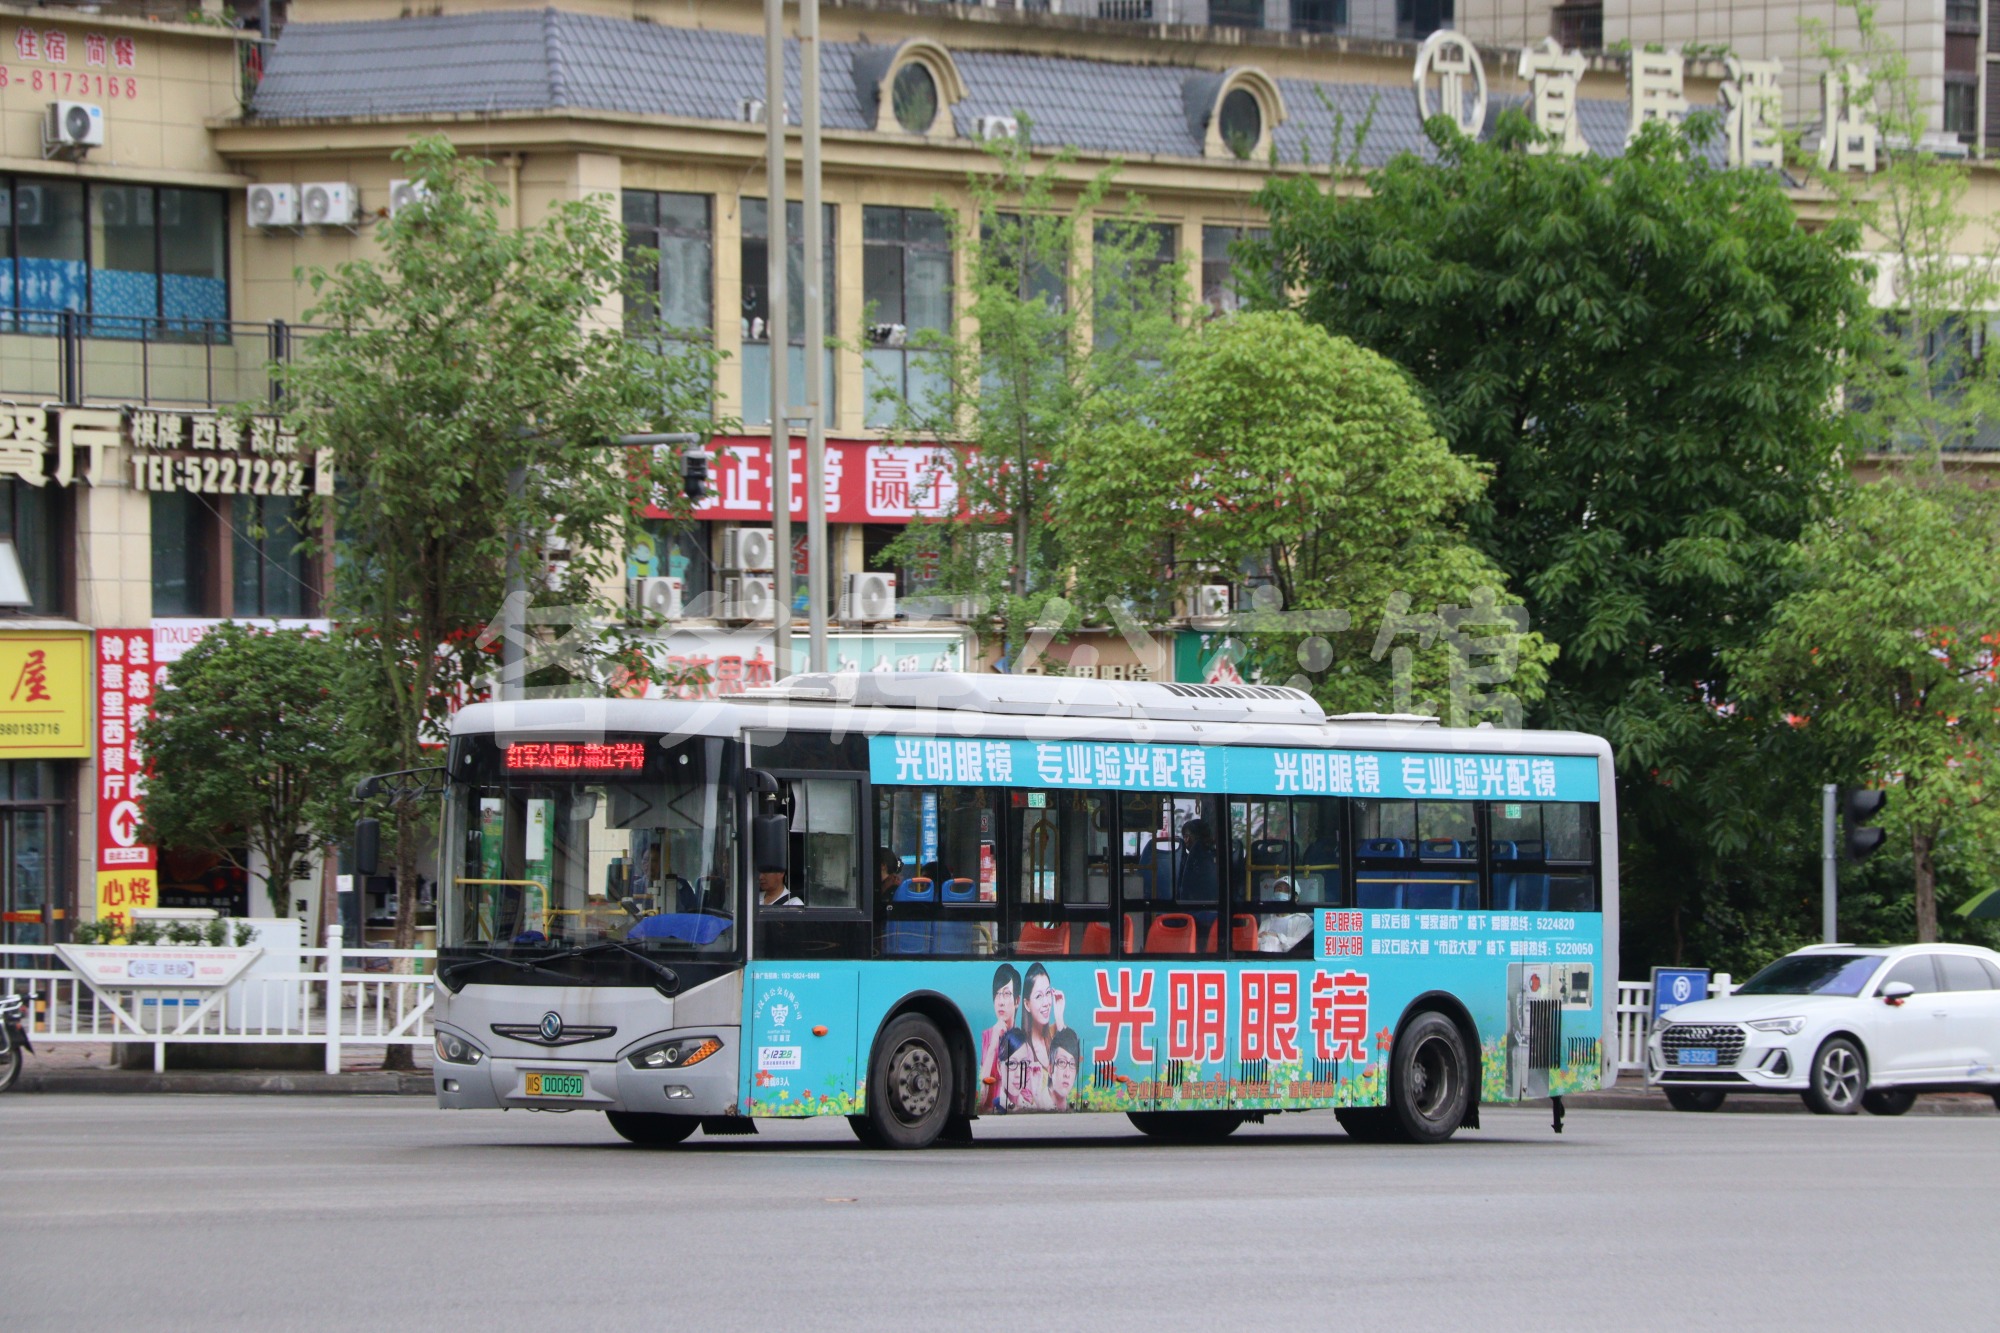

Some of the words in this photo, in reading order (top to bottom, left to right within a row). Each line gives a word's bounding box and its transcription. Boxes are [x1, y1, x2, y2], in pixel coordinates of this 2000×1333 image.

[15, 27, 68, 64] 住宿
[84, 33, 136, 70] 简餐
[0, 407, 122, 488] 餐厅
[131, 411, 182, 449] 棋牌
[192, 415, 240, 451] 西餐
[131, 455, 305, 496] TEL:5227222
[10, 649, 52, 703] 屋
[895, 740, 1013, 783] 光明眼镜
[1036, 744, 1207, 789] 专业验光配镜
[1274, 752, 1381, 794] 光明眼镜
[1401, 756, 1557, 797] 专业验光配镜
[1324, 911, 1364, 932] 配眼镜
[1324, 935, 1364, 956] 到光明
[1092, 967, 1370, 1065] 光明眼镜
[1181, 1081, 1229, 1100] 款式多样
[1236, 1081, 1282, 1099] 服务至上
[1288, 1081, 1335, 1099] 值得信赖
